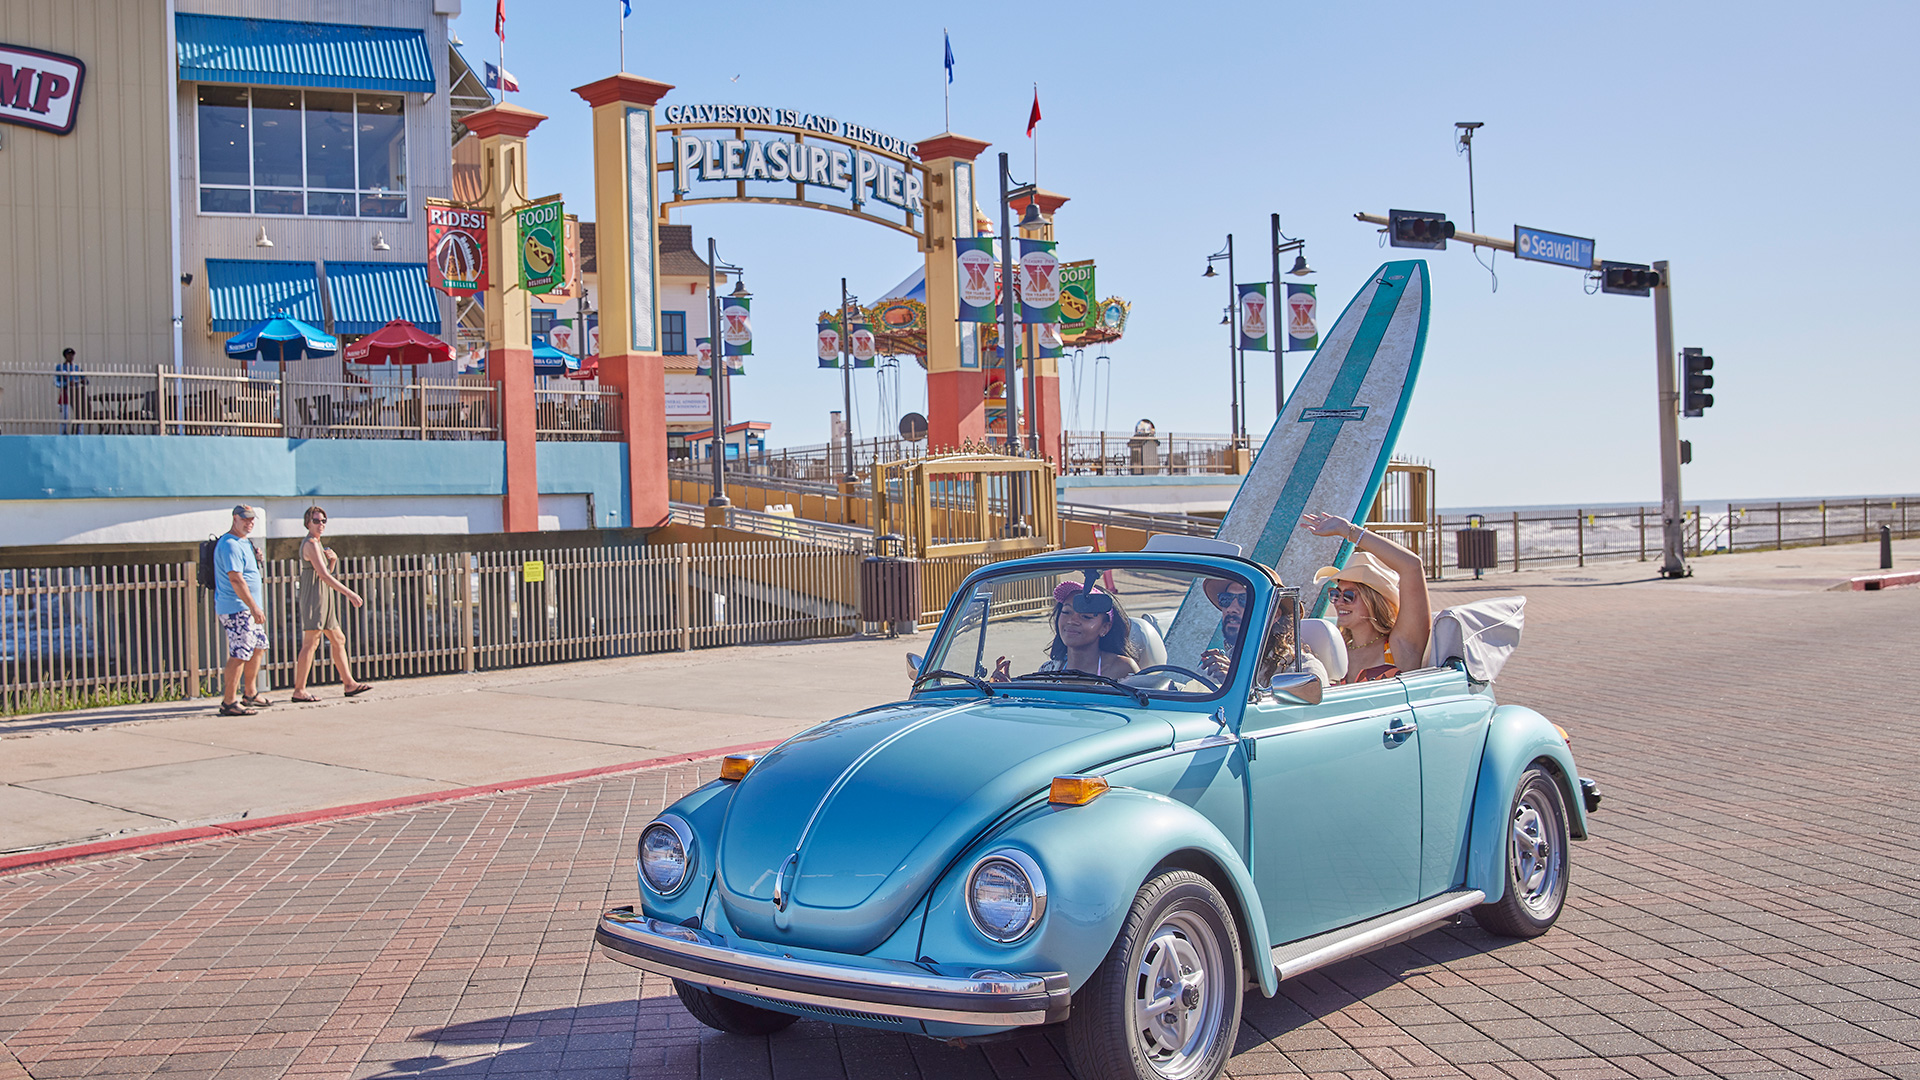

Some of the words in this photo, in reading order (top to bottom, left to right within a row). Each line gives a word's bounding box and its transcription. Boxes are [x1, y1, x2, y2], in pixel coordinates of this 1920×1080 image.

[0, 62, 70, 115] MP
[666, 104, 772, 124] GALVESTON
[777, 108, 840, 135] ISLAND
[843, 121, 920, 161] HISTORIC
[672, 135, 849, 194] PLEASURE
[850, 149, 923, 217] PIER
[431, 209, 485, 230] RIDES!
[519, 206, 558, 229] FOOD!
[1532, 235, 1579, 262] Seawall
[1059, 268, 1091, 283] OOD!
